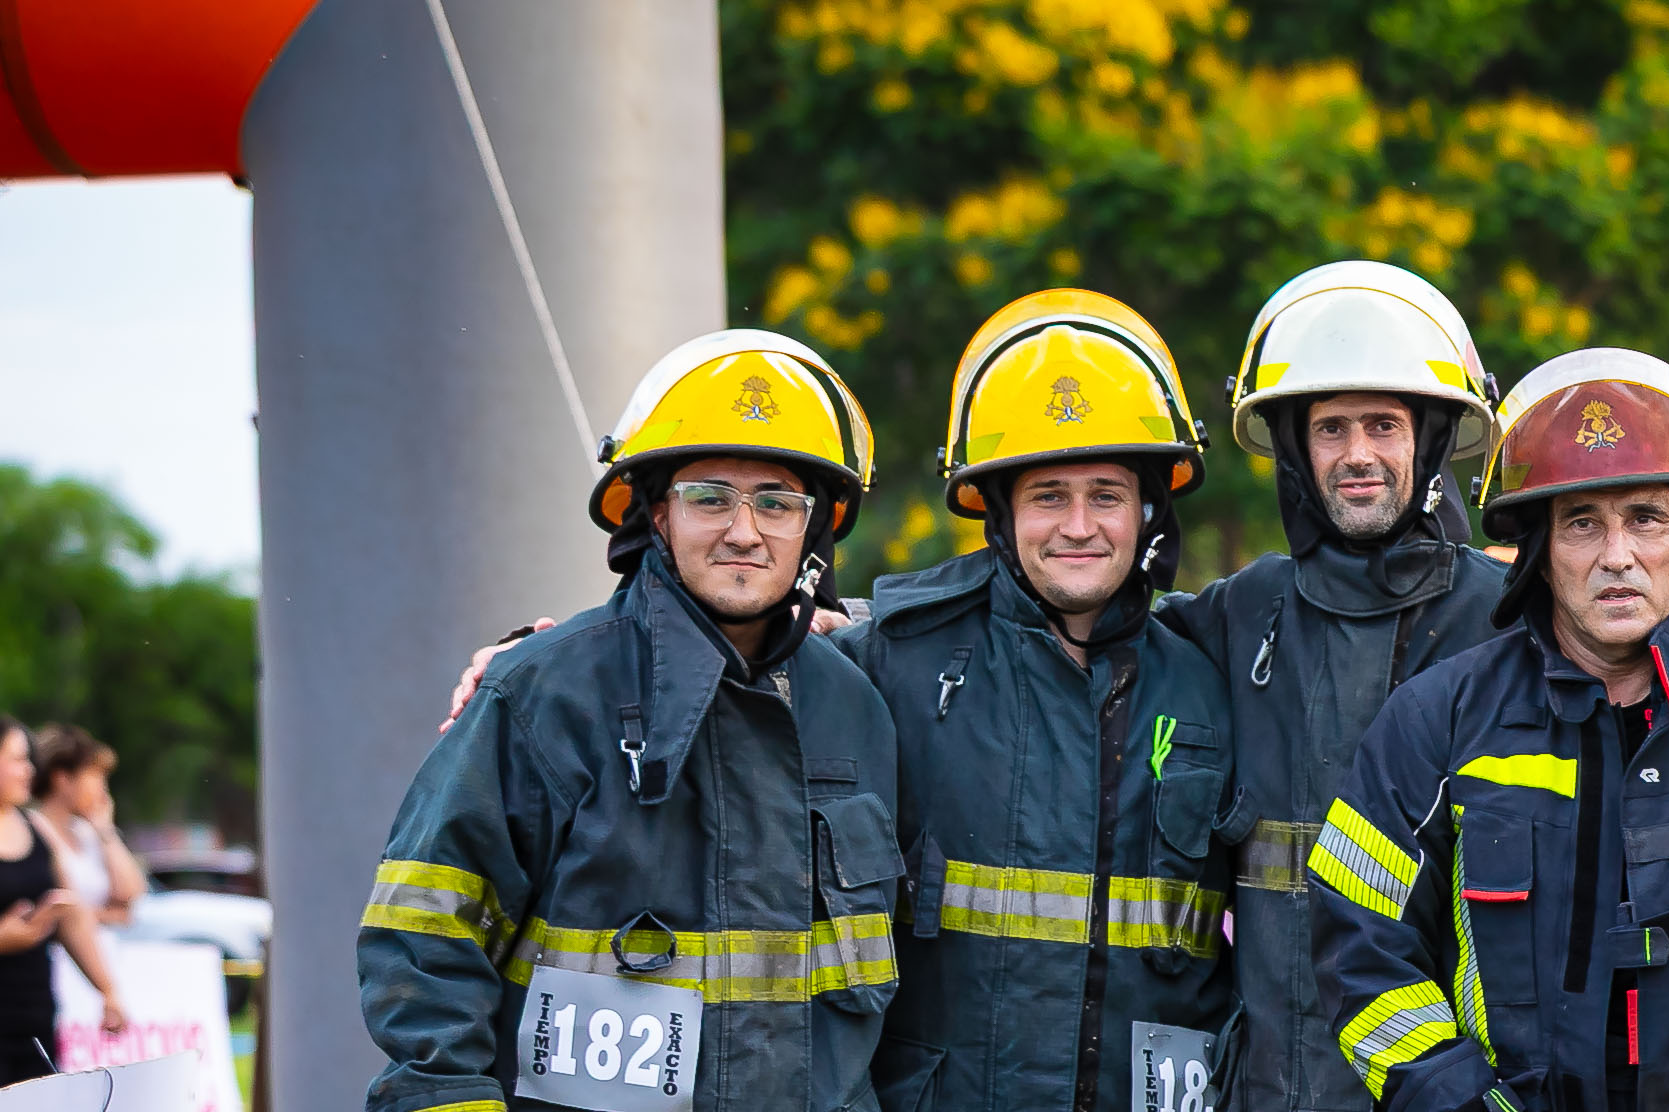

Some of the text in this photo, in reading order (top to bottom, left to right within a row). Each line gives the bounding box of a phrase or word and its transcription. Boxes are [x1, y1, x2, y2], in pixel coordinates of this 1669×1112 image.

[532, 992, 554, 1076] TIEMPO
[550, 1003, 665, 1088] 182
[662, 1012, 683, 1096] EXACTO
